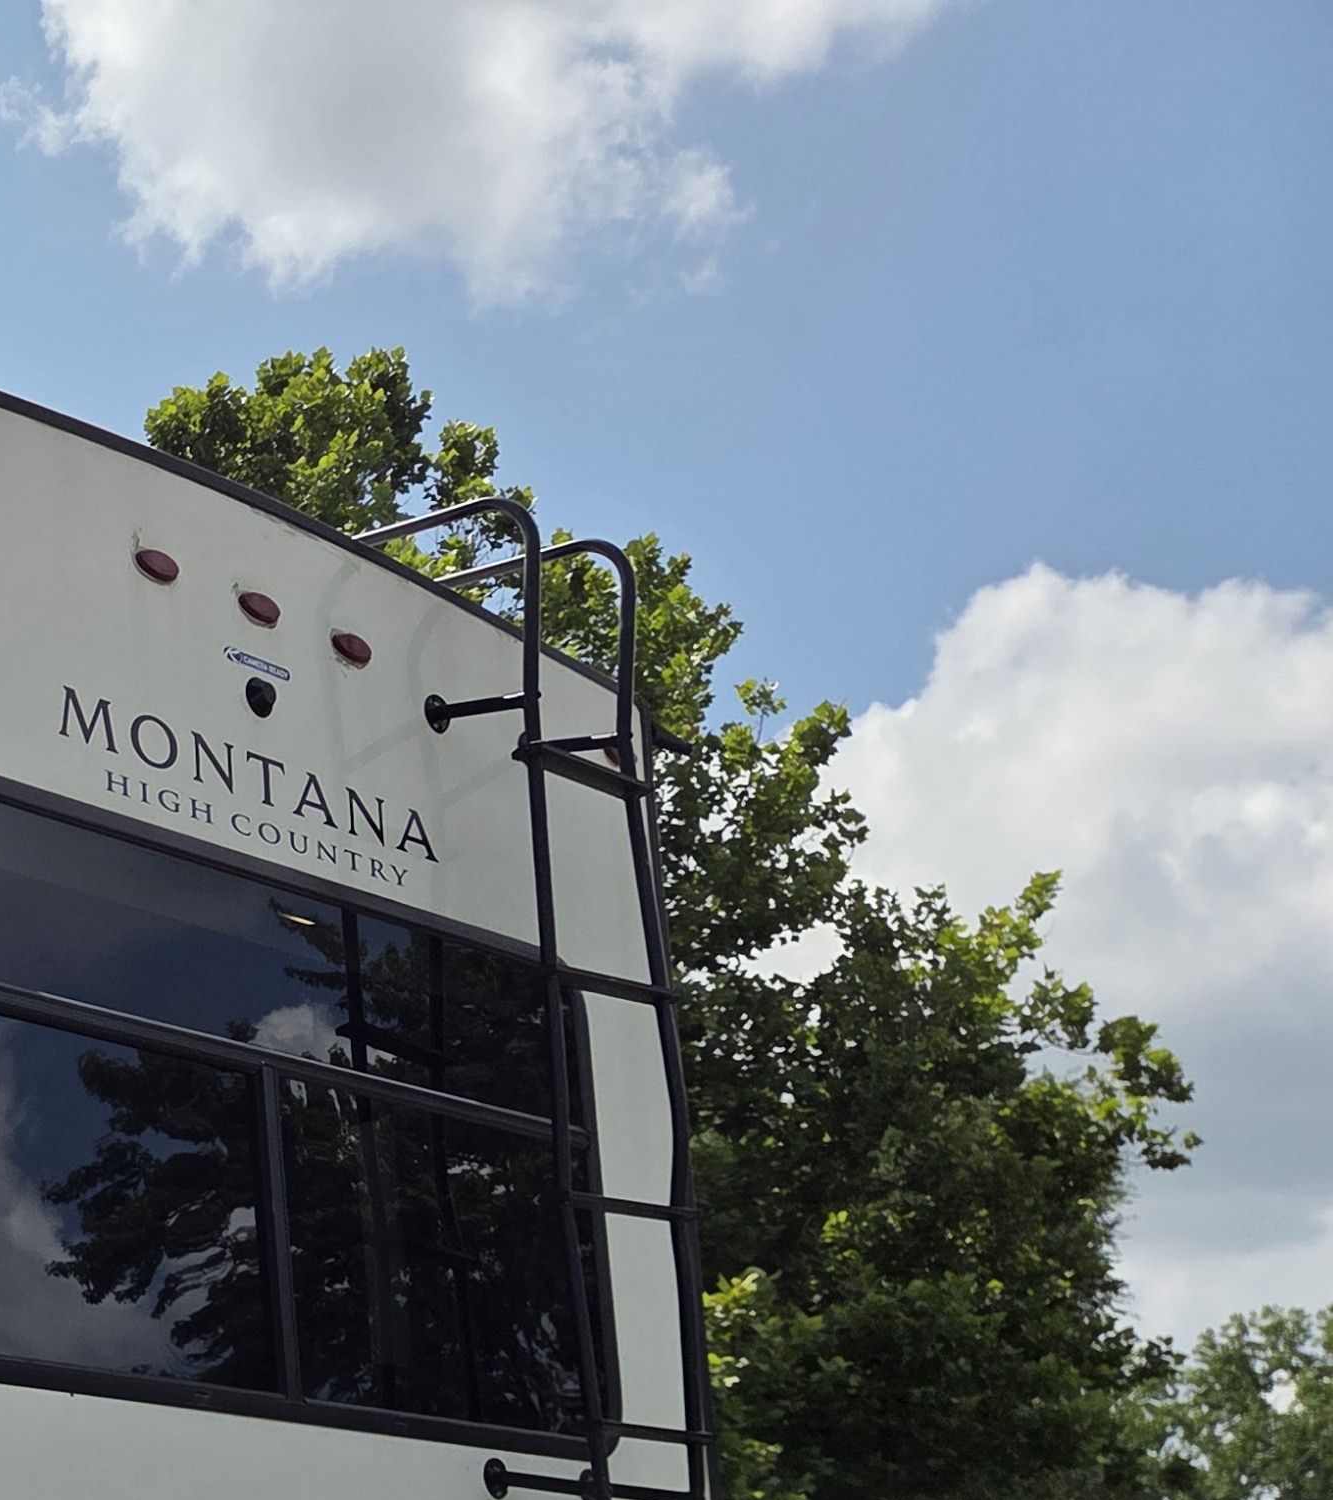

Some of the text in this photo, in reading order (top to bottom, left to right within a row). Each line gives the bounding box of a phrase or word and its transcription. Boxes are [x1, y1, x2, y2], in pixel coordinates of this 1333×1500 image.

[59, 685, 439, 863] MONTANA
[104, 769, 409, 886] HIGH COUNTRY
